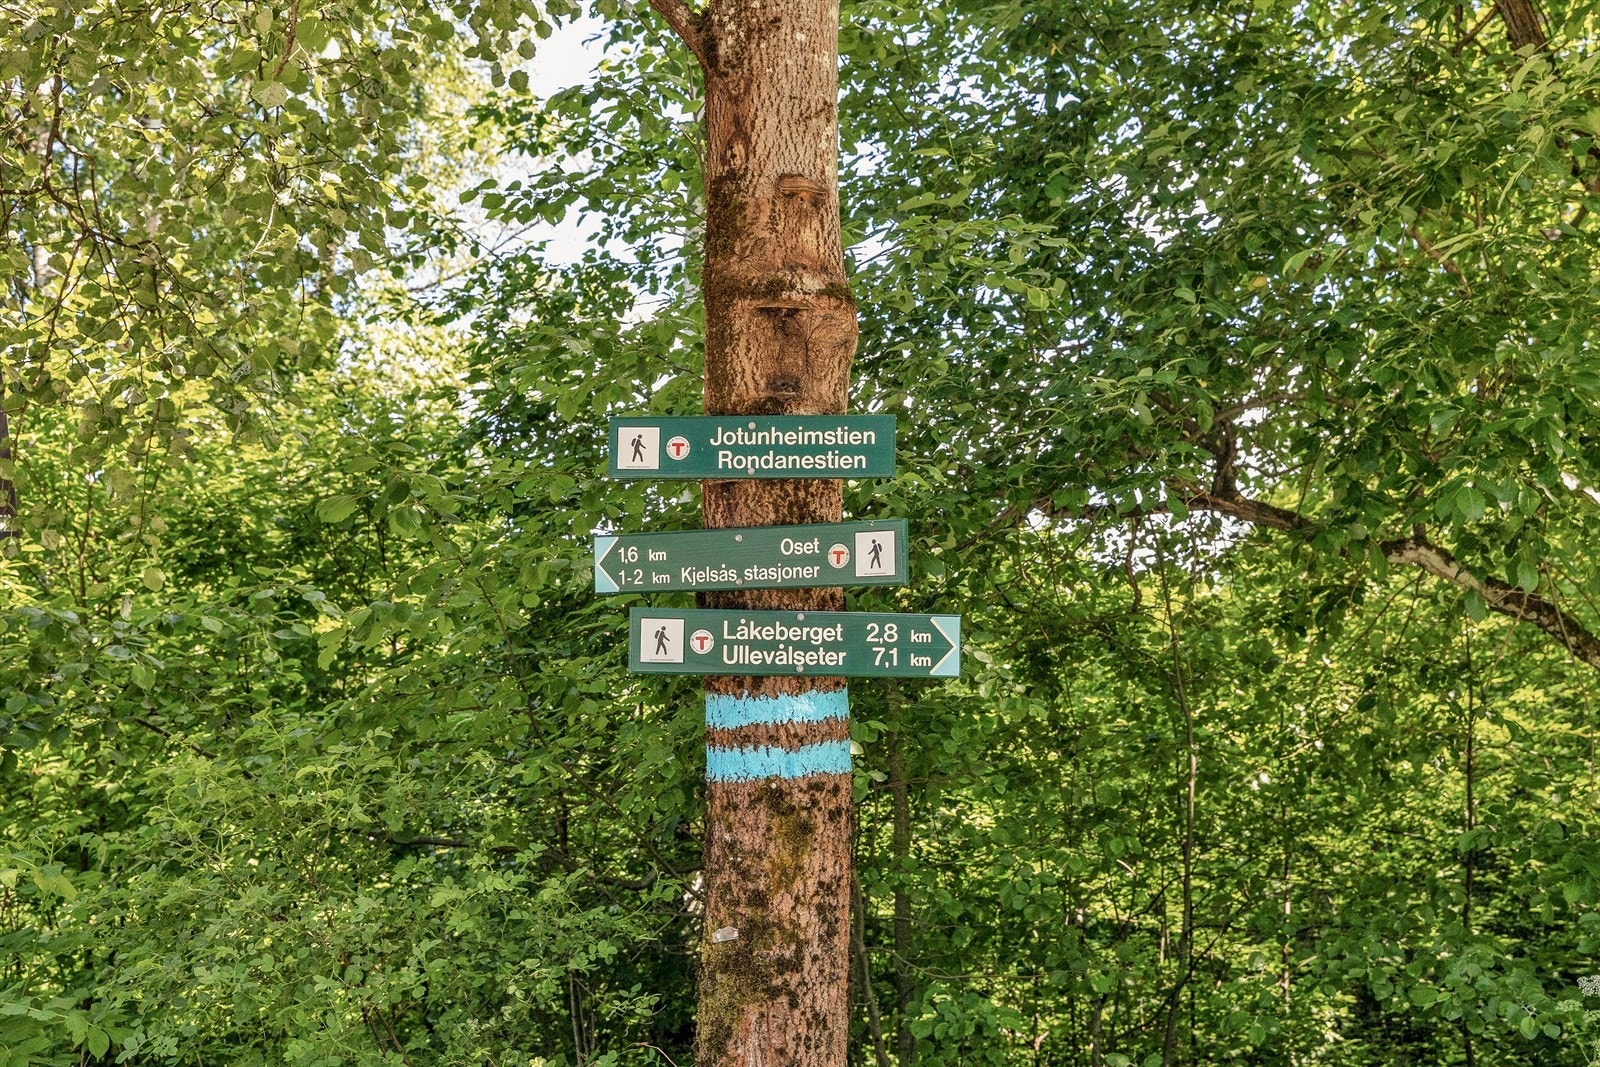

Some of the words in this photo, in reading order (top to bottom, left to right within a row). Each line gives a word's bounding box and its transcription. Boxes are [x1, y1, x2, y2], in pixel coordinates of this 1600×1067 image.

[710, 426, 876, 446] Jotunheimstien
[672, 443, 685, 456] T
[718, 451, 866, 469] Rondanestien
[618, 547, 638, 564] 1,6
[649, 549, 666, 561] km
[781, 538, 819, 555] Oset
[833, 550, 845, 564] T
[619, 569, 643, 585] 1-2
[653, 572, 670, 583] km
[681, 564, 737, 586] Kjelsås
[744, 564, 820, 583] stasjoner
[723, 618, 843, 645] Låkeberget
[866, 623, 898, 644] 2,8
[911, 630, 931, 642] km
[695, 636, 709, 650] T
[723, 643, 846, 666] Ullevålseter
[873, 647, 897, 668] 7,1
[911, 653, 931, 666] km
